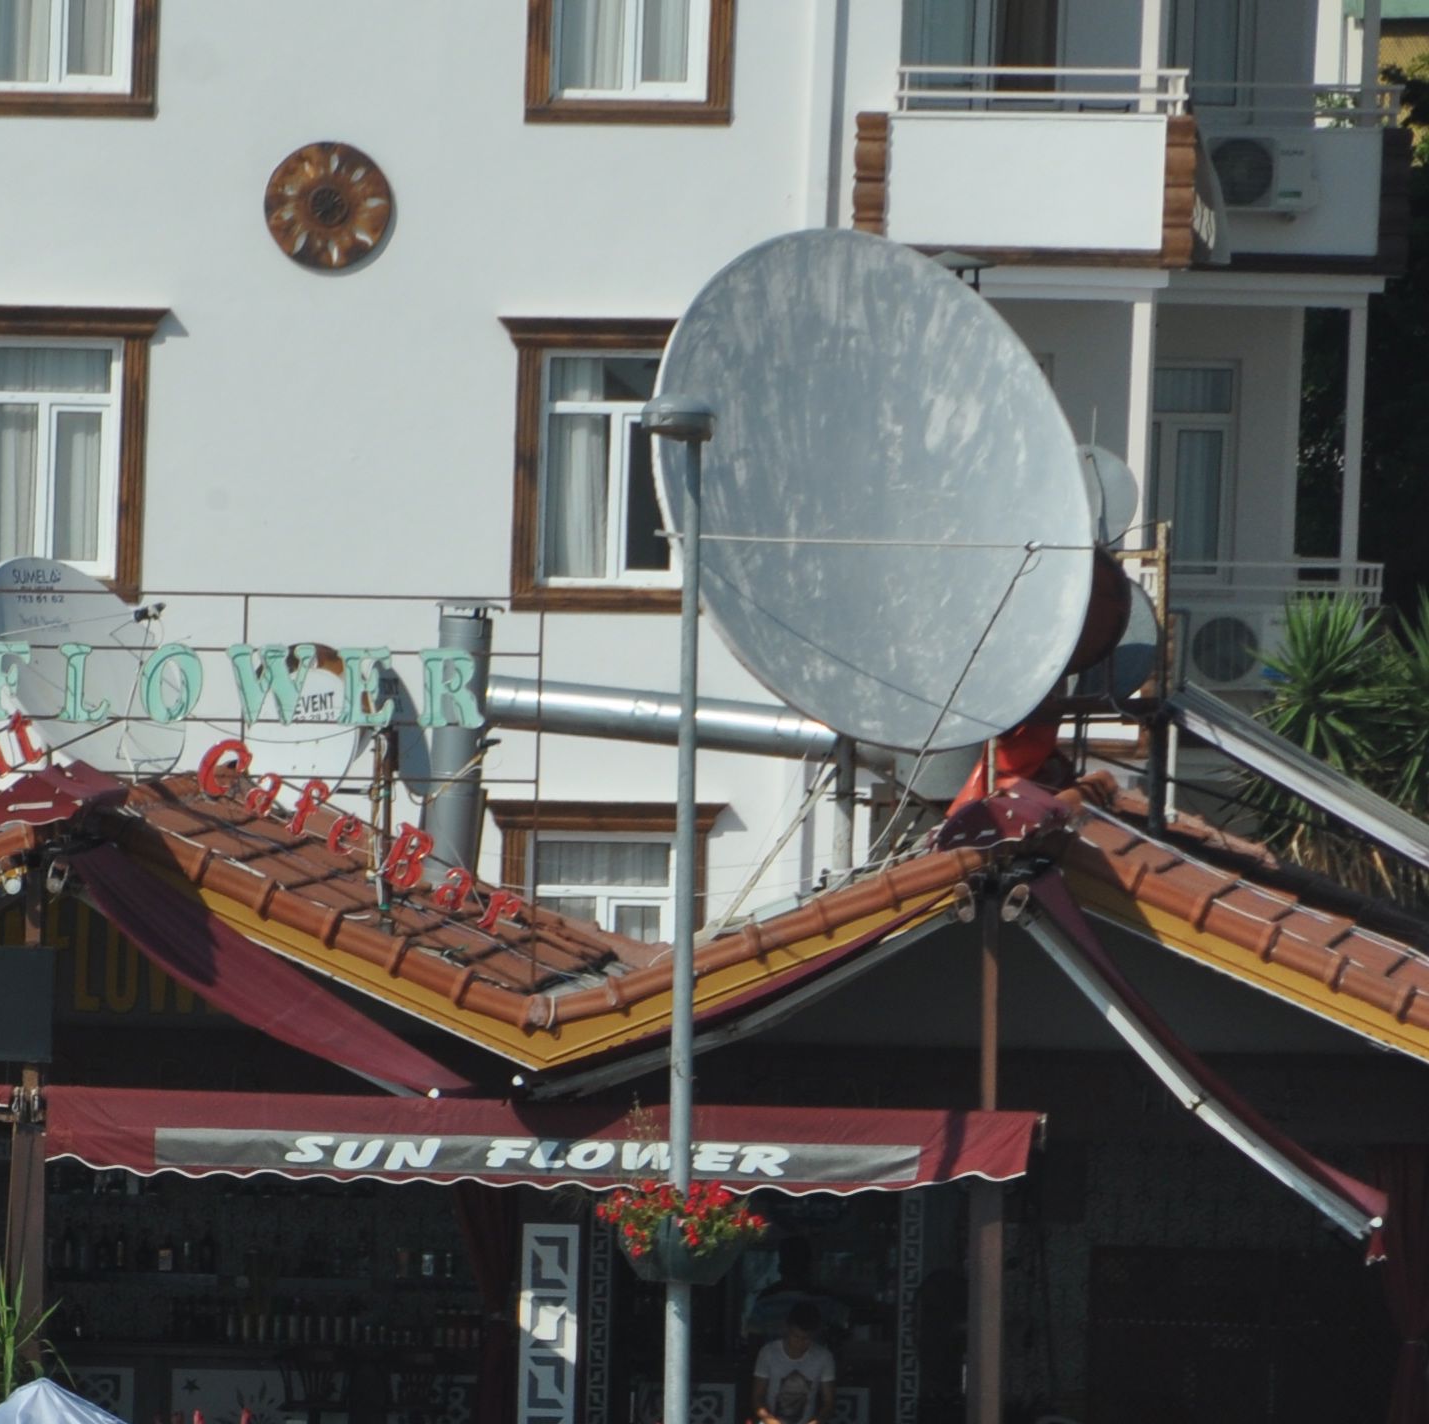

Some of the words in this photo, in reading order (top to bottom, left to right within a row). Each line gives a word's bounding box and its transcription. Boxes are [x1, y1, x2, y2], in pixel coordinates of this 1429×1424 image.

[197, 739, 366, 858] Cafe
[382, 820, 521, 932] Bar
[283, 1132, 444, 1171] SUN
[484, 1137, 793, 1178] FLOWER
